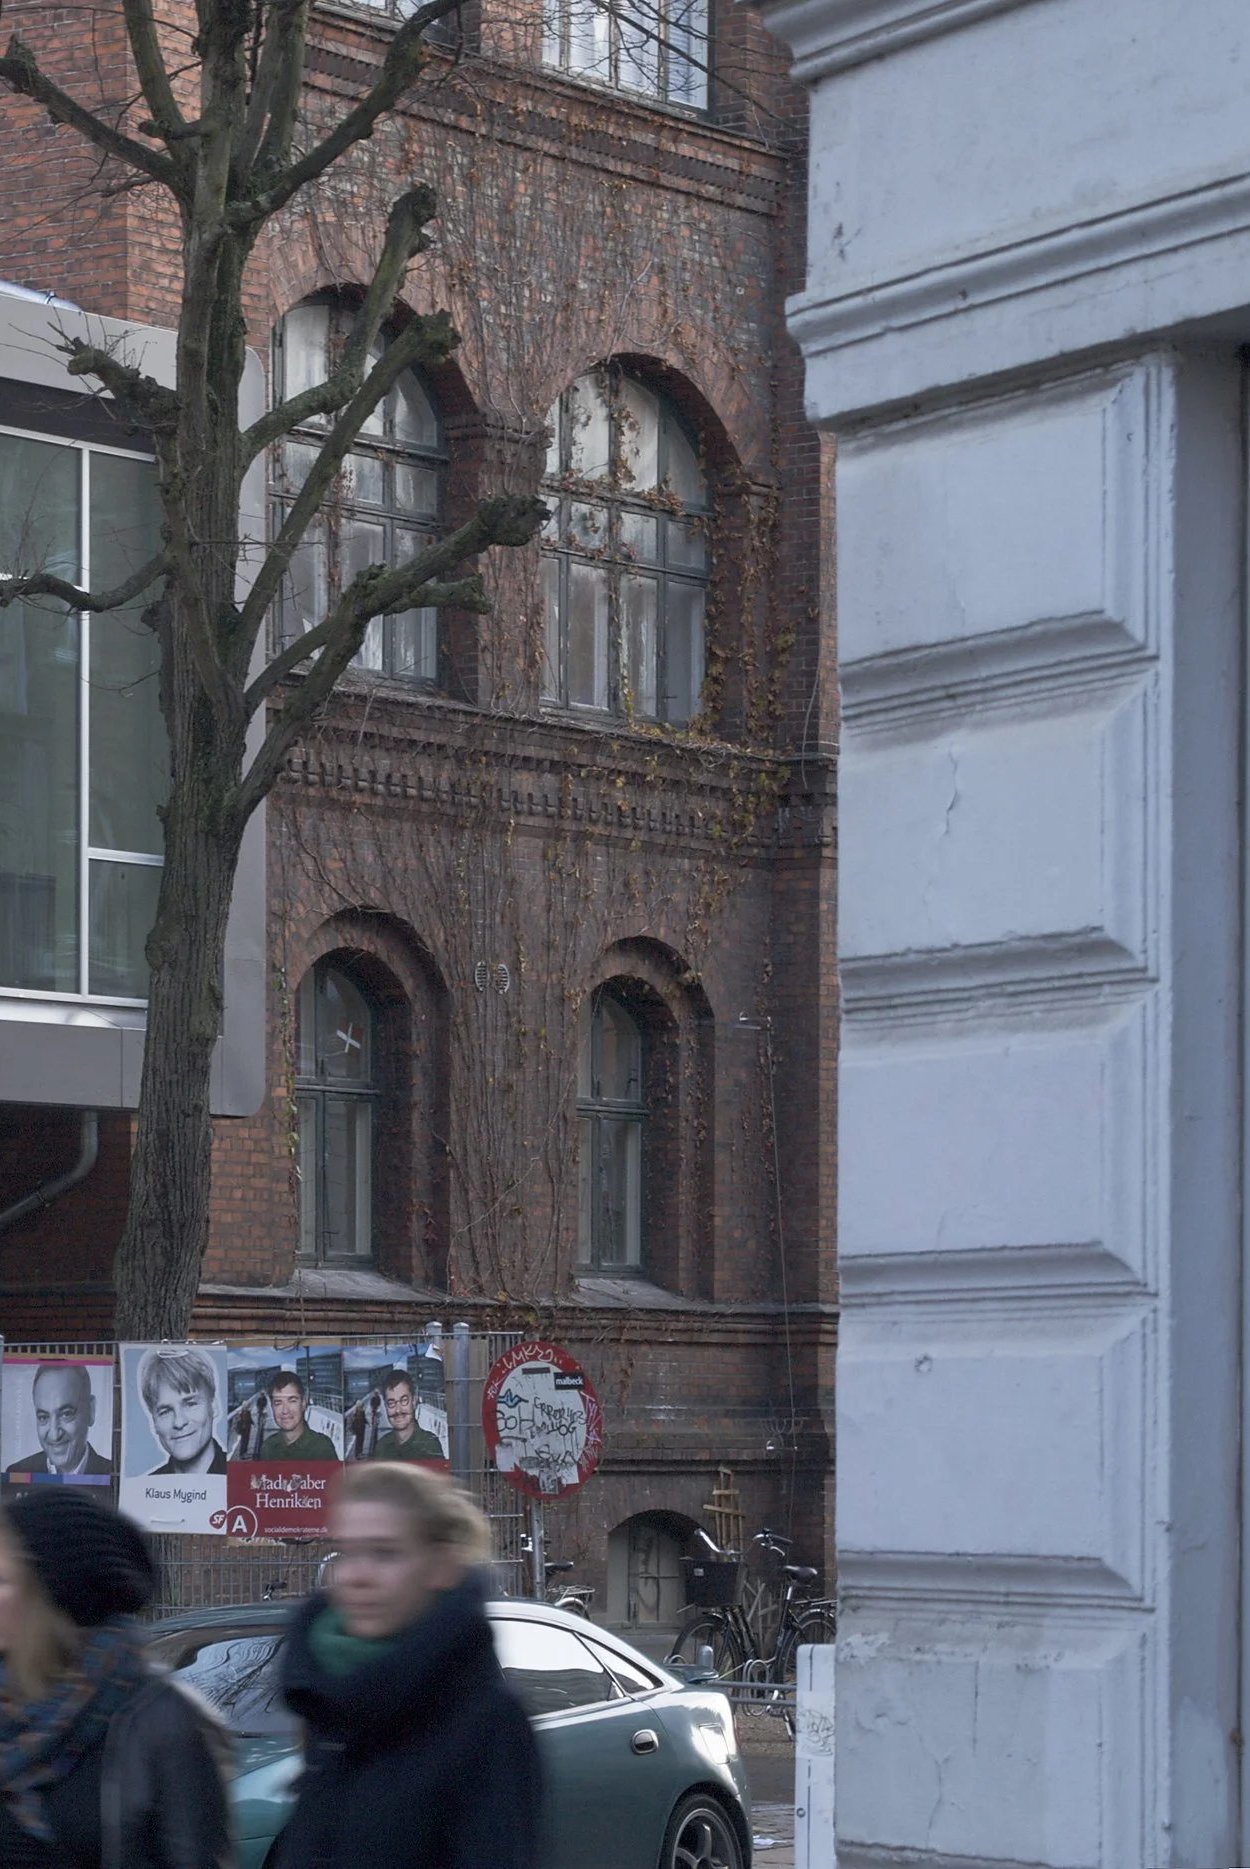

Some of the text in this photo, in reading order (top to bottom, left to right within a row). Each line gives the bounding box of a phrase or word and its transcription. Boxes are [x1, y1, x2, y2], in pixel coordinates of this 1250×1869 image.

[145, 1488, 207, 1503] Klaus Mygind
[212, 1514, 225, 1525] SF
[231, 1515, 248, 1533] A
